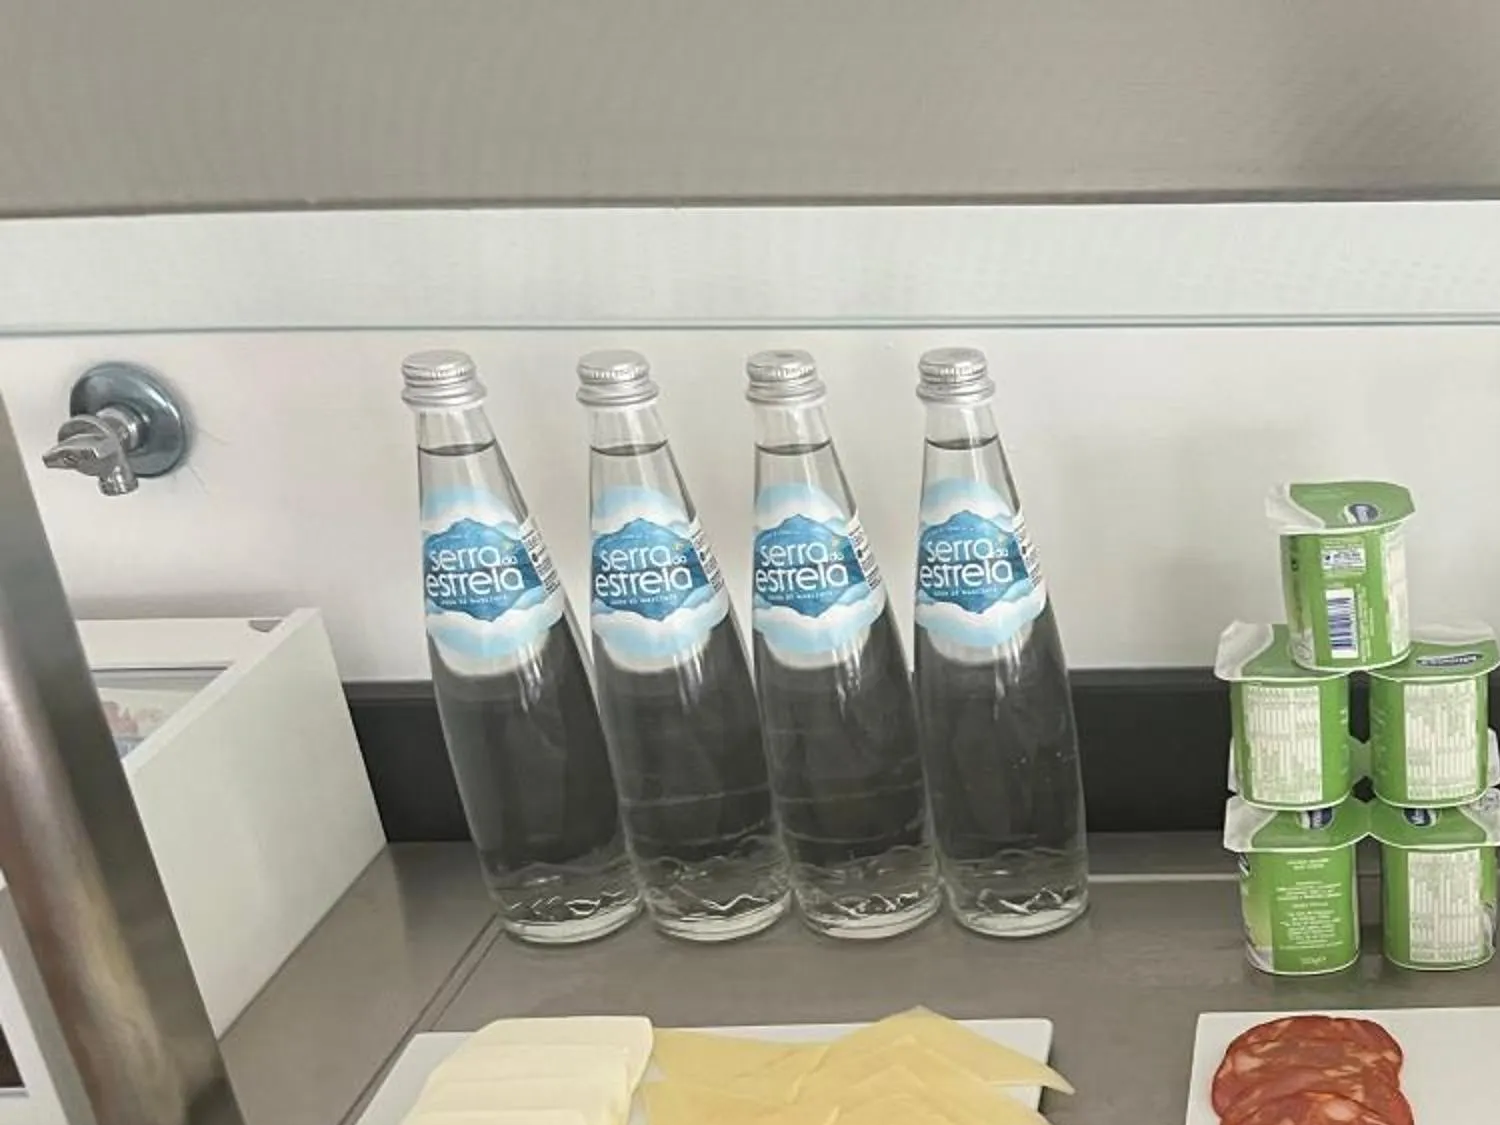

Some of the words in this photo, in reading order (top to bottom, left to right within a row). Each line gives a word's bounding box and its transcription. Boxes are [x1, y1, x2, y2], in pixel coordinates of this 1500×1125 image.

[429, 545, 501, 571] serra
[600, 545, 672, 571] serra
[760, 542, 829, 567] serra
[927, 538, 995, 562] serra
[426, 567, 525, 597] estrela
[595, 567, 693, 597] estrela
[755, 562, 849, 593] estrela
[920, 559, 1014, 588] estrela
